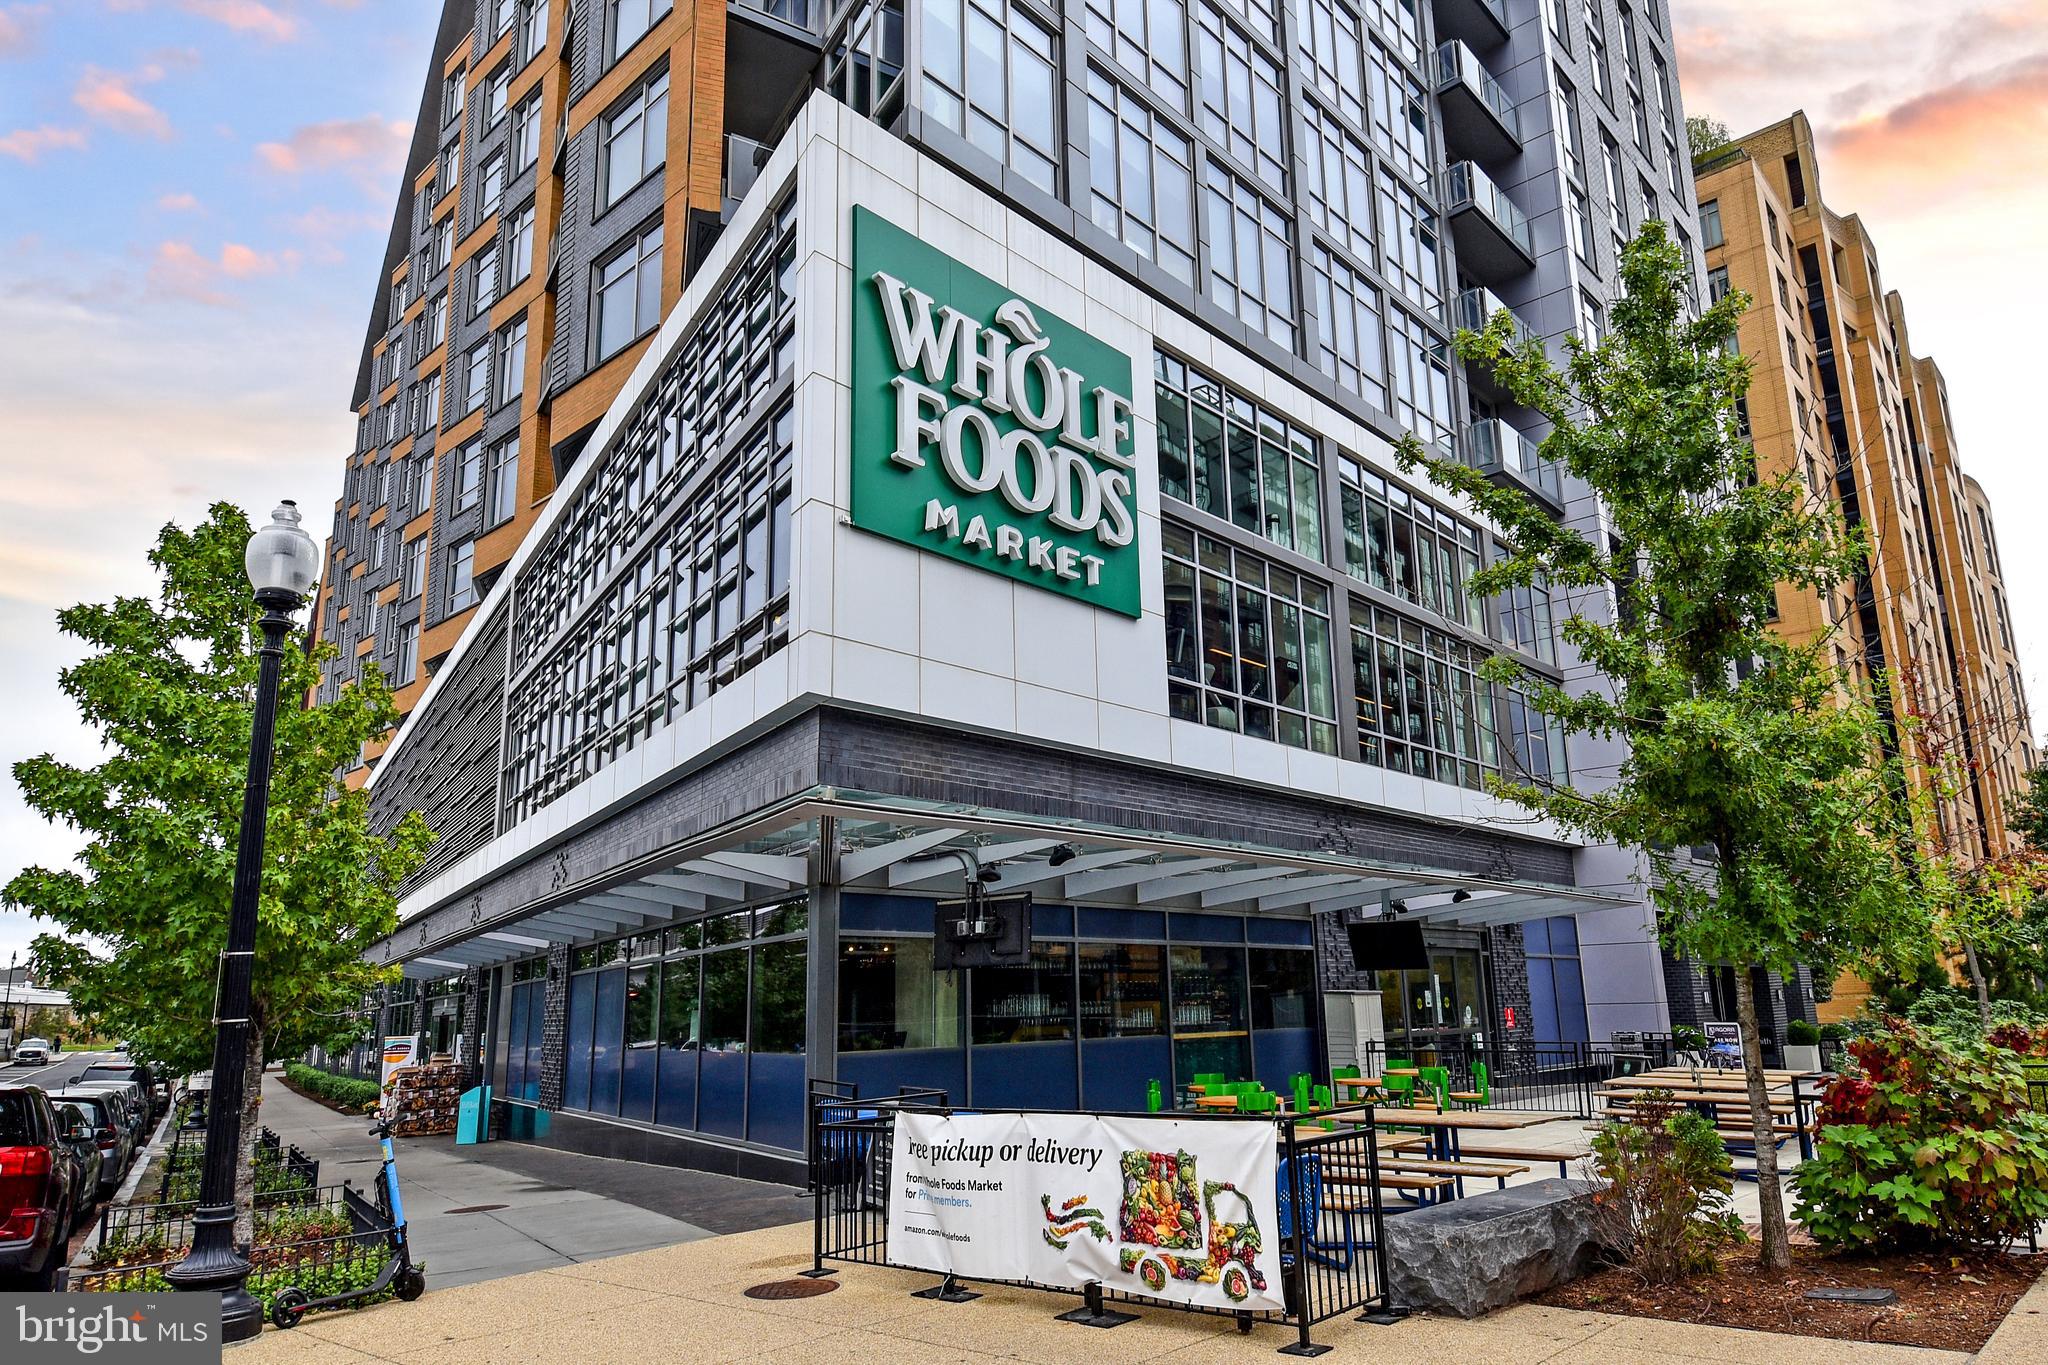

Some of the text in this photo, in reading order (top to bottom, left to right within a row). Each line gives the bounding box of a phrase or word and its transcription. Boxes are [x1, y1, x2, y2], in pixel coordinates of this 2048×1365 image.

[872, 271, 1136, 469] WHOLE
[890, 376, 1134, 547] FOODS
[924, 498, 1104, 586] MARKET
[931, 1138, 994, 1168] pickup
[1000, 1143, 1022, 1162] or
[1027, 1138, 1103, 1172] delivery
[905, 1188, 972, 1208] for Pri members.
[941, 1179, 966, 1191] Foods
[967, 1179, 1003, 1191] Market
[904, 1225, 971, 1242] amazon.com/wolefoods
